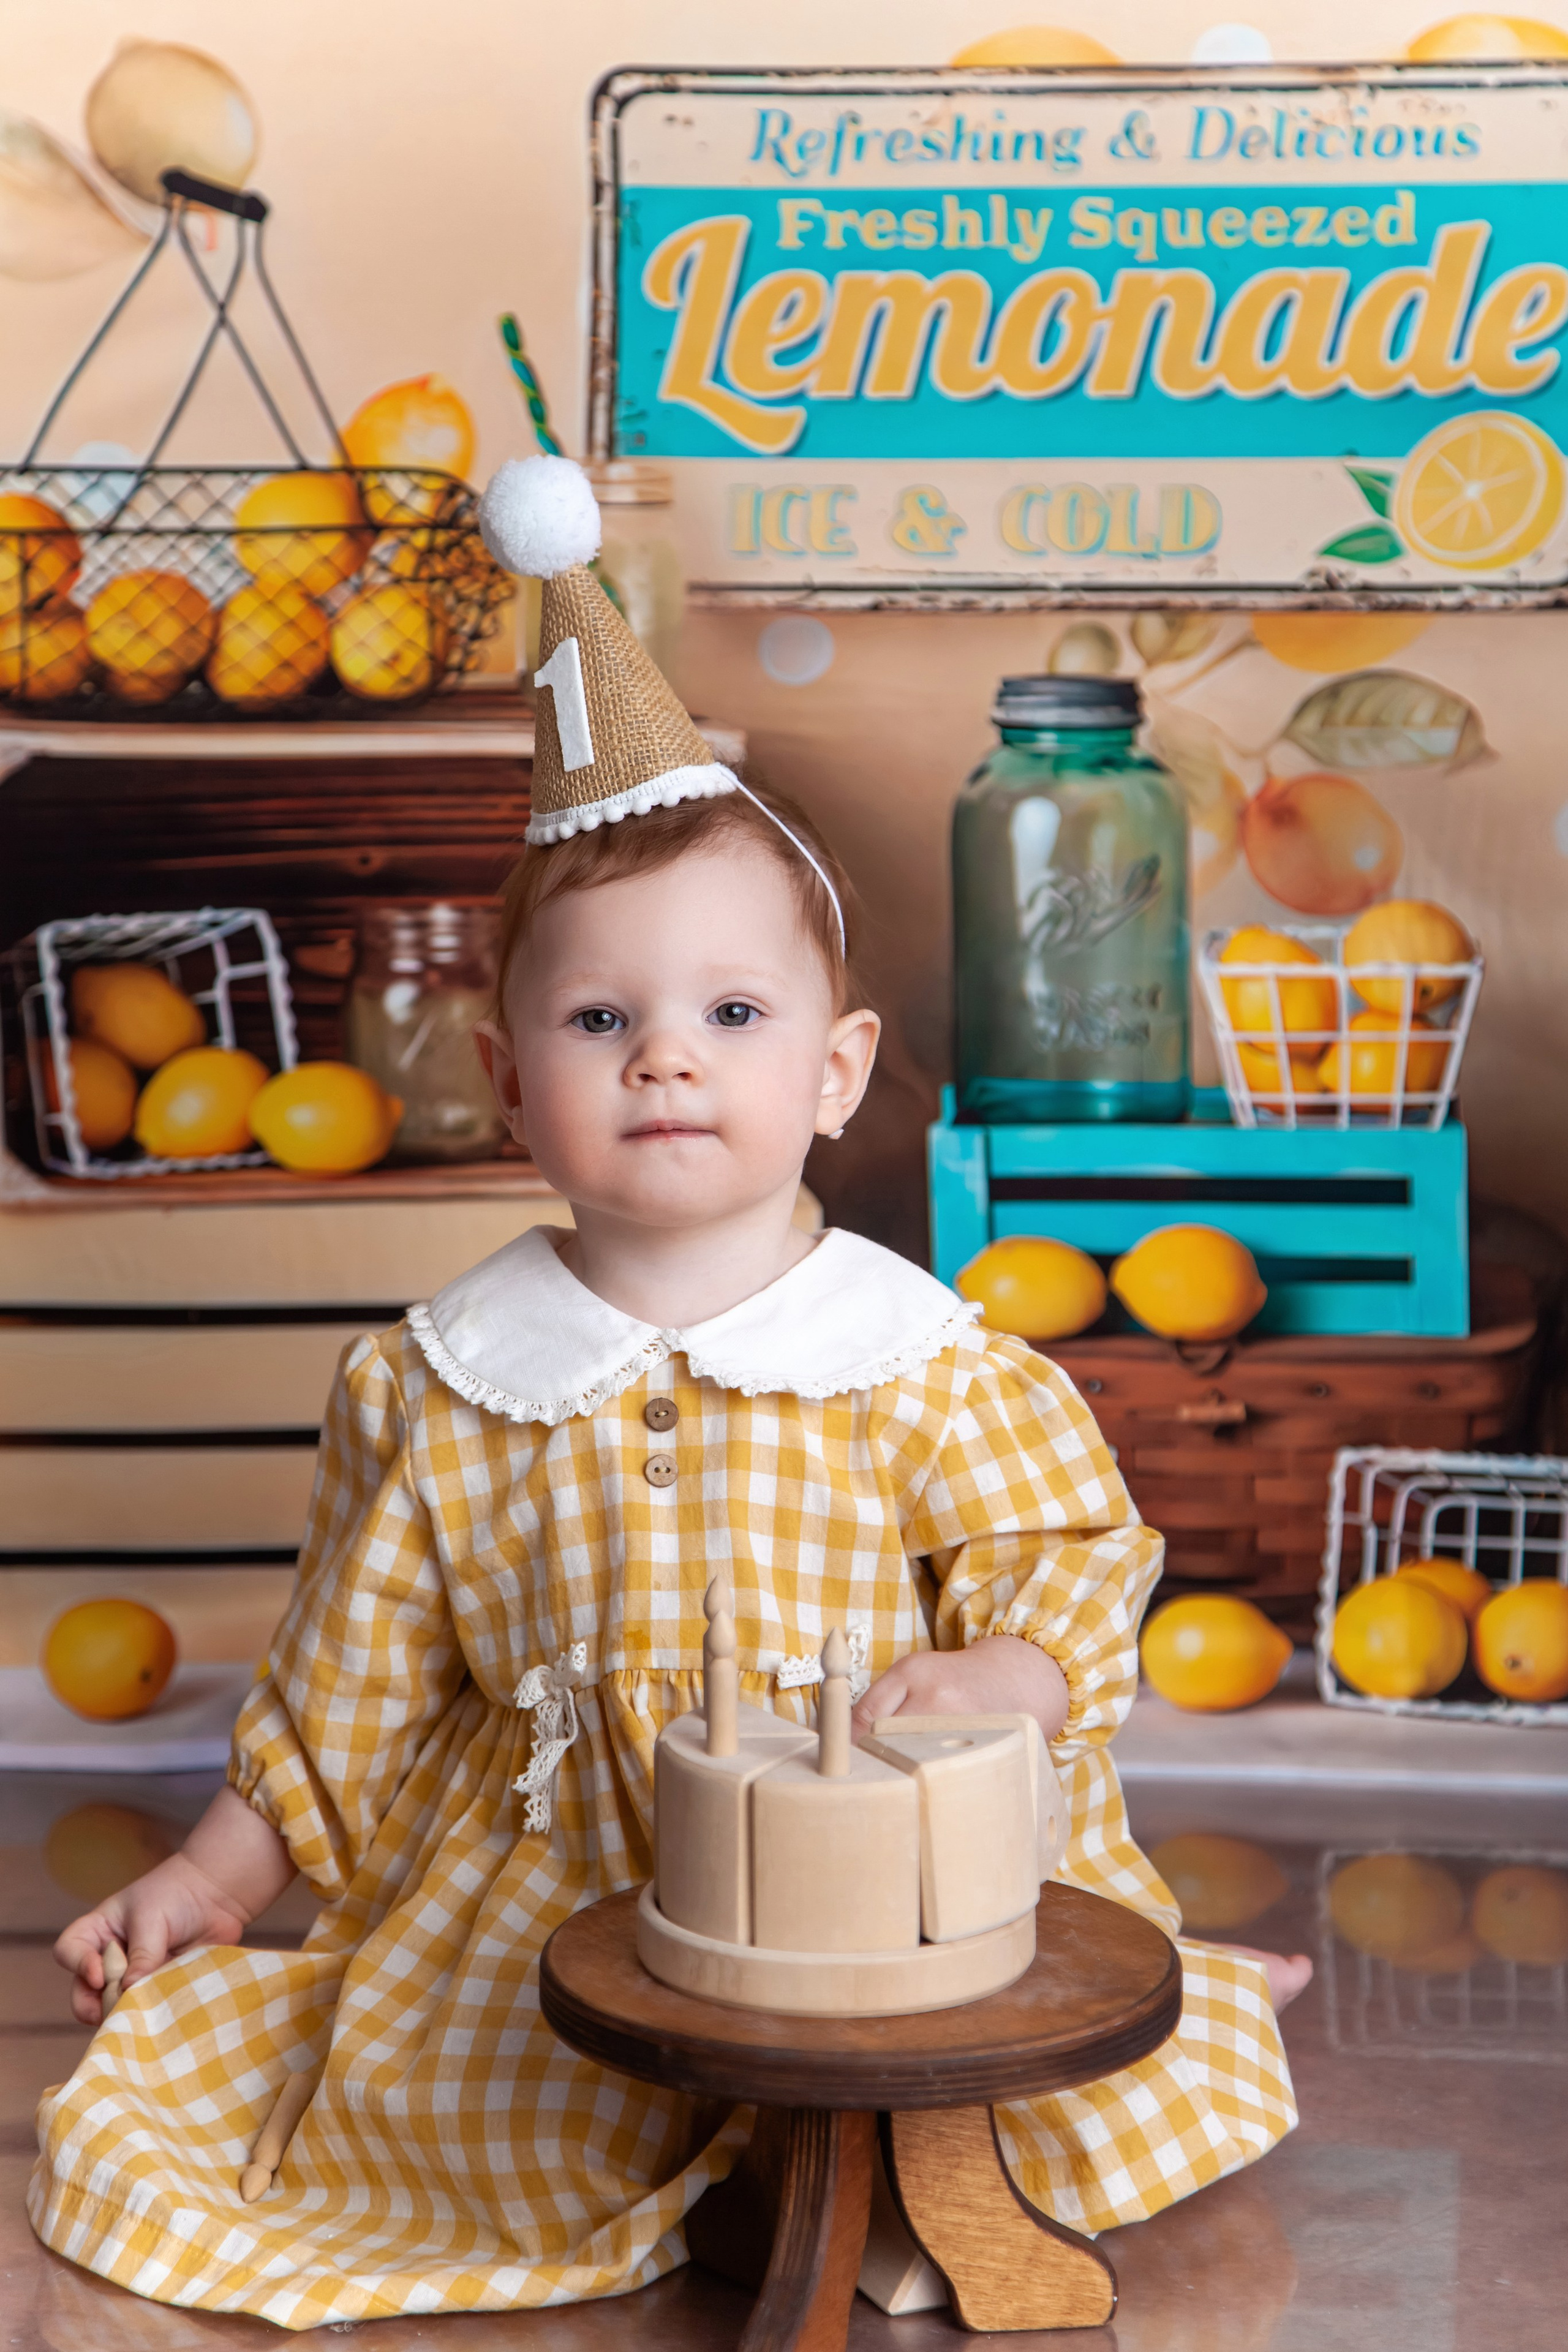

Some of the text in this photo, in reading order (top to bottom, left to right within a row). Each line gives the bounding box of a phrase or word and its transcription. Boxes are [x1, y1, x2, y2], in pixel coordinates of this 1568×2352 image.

[750, 105, 1482, 176] Refreshing & Delicious
[777, 190, 1417, 262] Freshly Squeezed
[643, 216, 1568, 453] Lemonade
[729, 482, 1223, 558] ICE & COLD
[534, 637, 595, 772] 1
